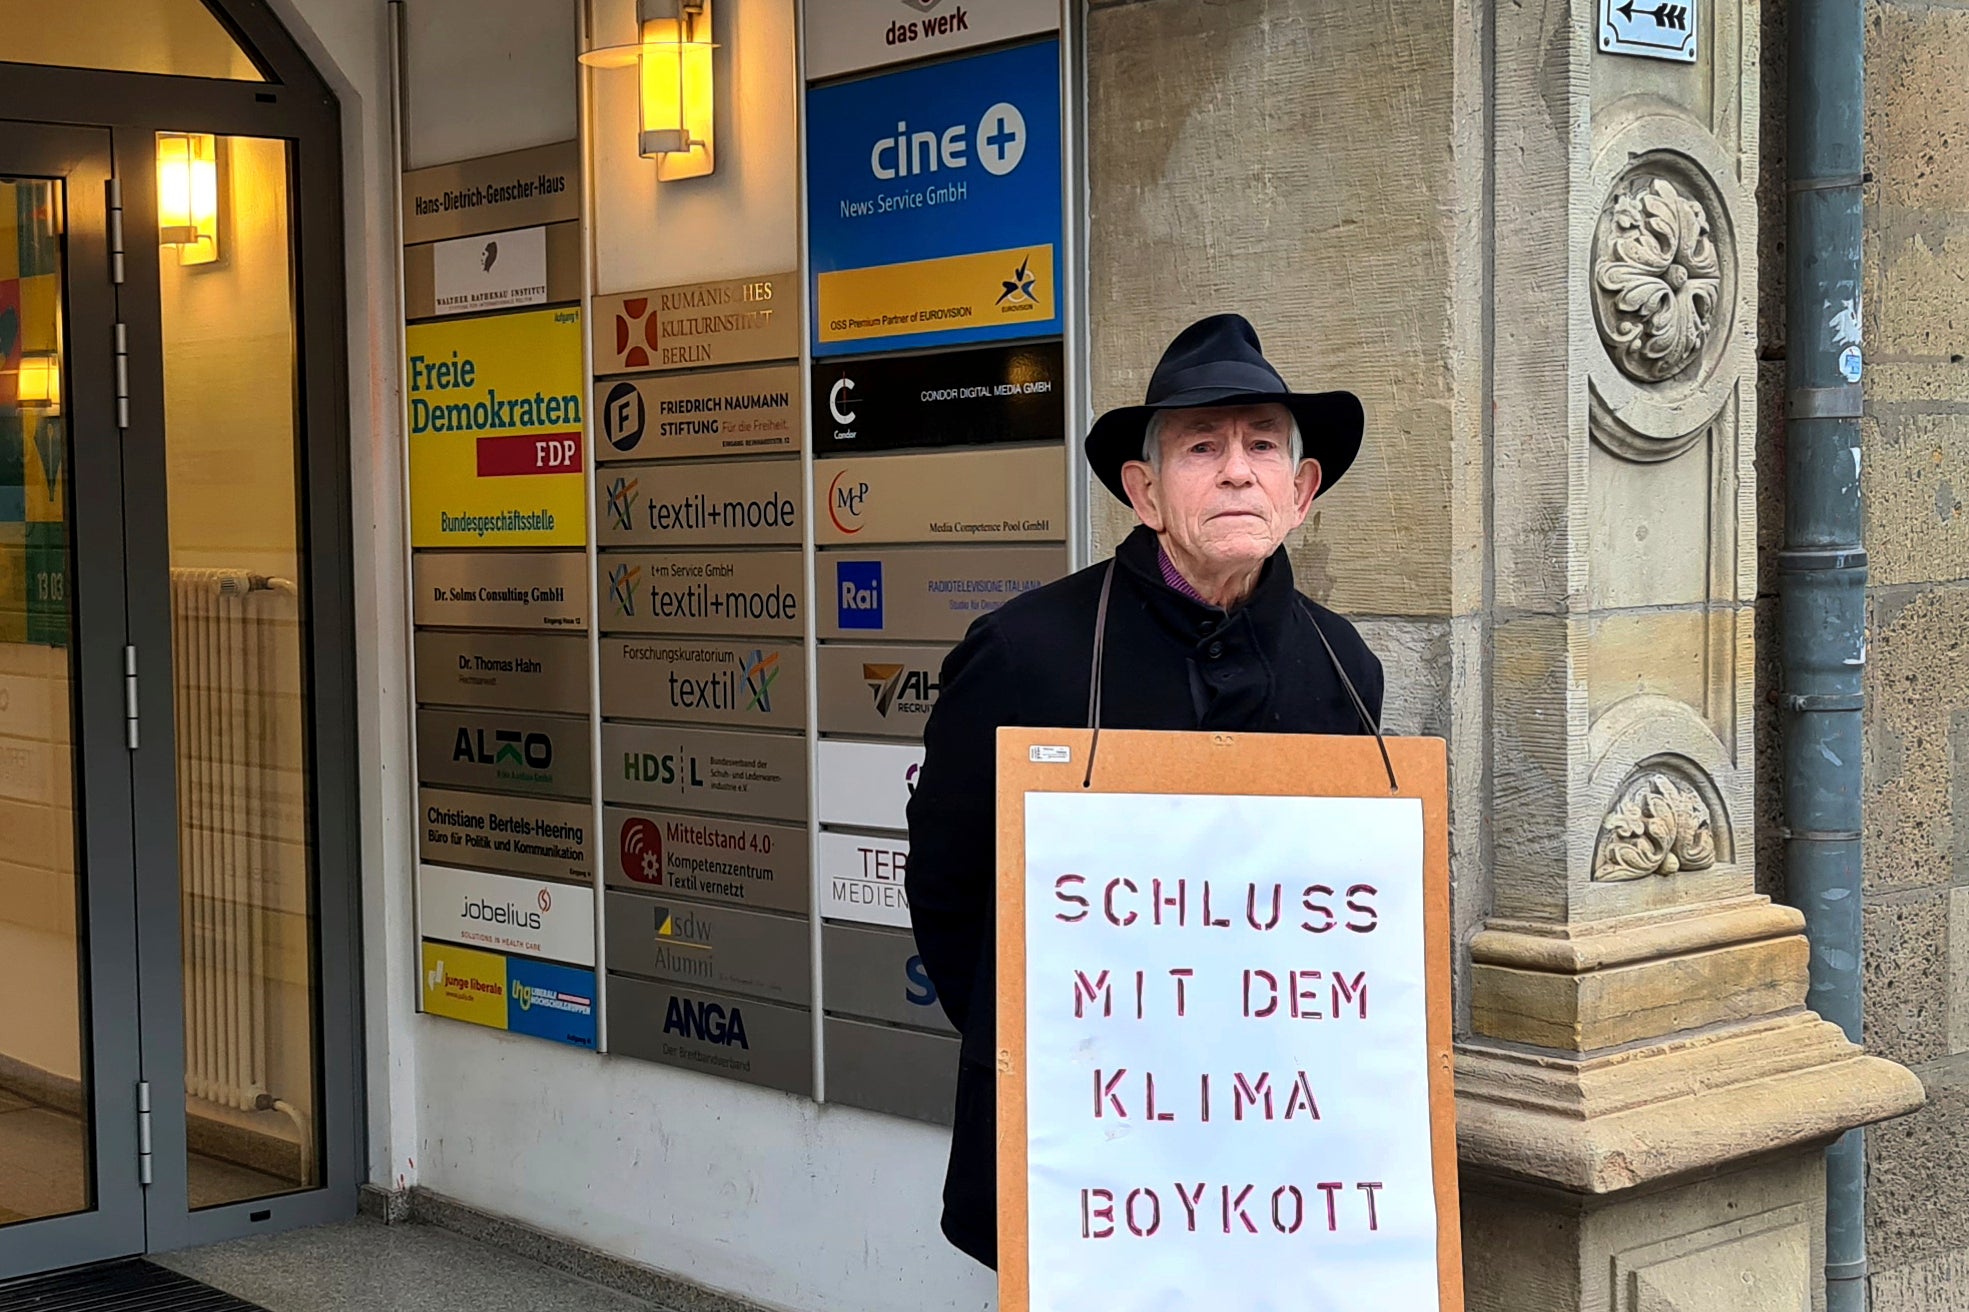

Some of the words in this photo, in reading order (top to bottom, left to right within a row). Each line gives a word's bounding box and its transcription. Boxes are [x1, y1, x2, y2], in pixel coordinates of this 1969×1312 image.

[885, 20, 918, 45] das
[922, 6, 968, 38] werk
[871, 121, 967, 180] cine
[415, 175, 565, 216] Hans-Dietrich-Genscher-Haus
[841, 200, 874, 218] News
[878, 186, 922, 214] Service
[927, 181, 967, 204] GmbH
[437, 294, 468, 306] WALTHER
[471, 290, 508, 302] RATHENAU
[511, 285, 545, 297] INSTITUT
[1001, 303, 1034, 313] EUROVISION
[830, 319, 847, 331] OSS
[848, 317, 881, 329] Premium
[882, 313, 909, 326] Partner
[910, 311, 918, 322] of
[919, 306, 972, 321] EUROVISION
[662, 344, 712, 365] BERLIN
[410, 350, 475, 392] Freie
[660, 397, 722, 415] FRIEDRICH
[724, 392, 789, 410] NAUMANN
[920, 388, 958, 402] CONDOR
[960, 385, 992, 399] DIGITAL
[994, 383, 1022, 396] MEDIA
[1023, 381, 1051, 395] GMBH
[411, 389, 582, 434] Demokraten
[618, 401, 630, 433] F
[660, 419, 719, 436] STIFTUNG
[722, 420, 736, 433] Für
[738, 420, 752, 433] die
[834, 428, 857, 440] Condor
[535, 440, 576, 467] FDP
[441, 509, 555, 538] Bundesgeschäftsstelle
[648, 491, 795, 529] textil+mode
[929, 521, 953, 533] Media
[954, 521, 1001, 535] Competence
[1003, 520, 1021, 532] Pool
[1022, 519, 1049, 532] GmbH
[651, 564, 669, 577] t+m
[671, 563, 703, 577] Service
[705, 563, 734, 577] GmbH
[434, 587, 448, 601] Dr.
[450, 587, 477, 601] Solms
[478, 587, 529, 605] Consulting
[531, 587, 564, 601] GmbH
[651, 583, 796, 620] textil+mode
[841, 579, 878, 609] Rai
[928, 580, 1003, 593] RADIOTELEVISIONE
[458, 655, 473, 670] Dr.
[474, 655, 513, 672] Thomas
[515, 658, 542, 673] Hahn
[623, 644, 734, 664] Forschungskuratorium
[668, 670, 735, 710] textil
[624, 752, 676, 785] HDS
[427, 806, 485, 830] Christiane
[489, 813, 583, 845] Bertels-Heering
[666, 821, 746, 852] Mittelstand
[428, 829, 449, 844] Büro
[450, 831, 462, 845] für
[465, 833, 491, 850] Politik
[494, 836, 511, 852] und
[513, 839, 584, 862] Kommunikation
[667, 851, 774, 882] Kompetenzzentrum
[667, 872, 698, 891] Textil
[699, 880, 745, 899] vernetzt
[461, 896, 541, 930] jobelius
[1054, 873, 1379, 935] SCHLUSS
[461, 930, 493, 944] SOLUTIONS
[494, 936, 501, 945] IN
[502, 938, 525, 949] HEALTH
[526, 942, 541, 952] CARE
[674, 911, 712, 941] sdw
[654, 946, 713, 978] Alumni
[444, 972, 469, 991] junge
[470, 978, 503, 996] liberale
[1073, 967, 1195, 1020] MIT
[1241, 968, 1368, 1021] DEM
[663, 995, 750, 1051] ANGA
[662, 1043, 678, 1056] Der
[1093, 1067, 1322, 1122] KLIMA
[1080, 1181, 1385, 1239] BOYKOTT
